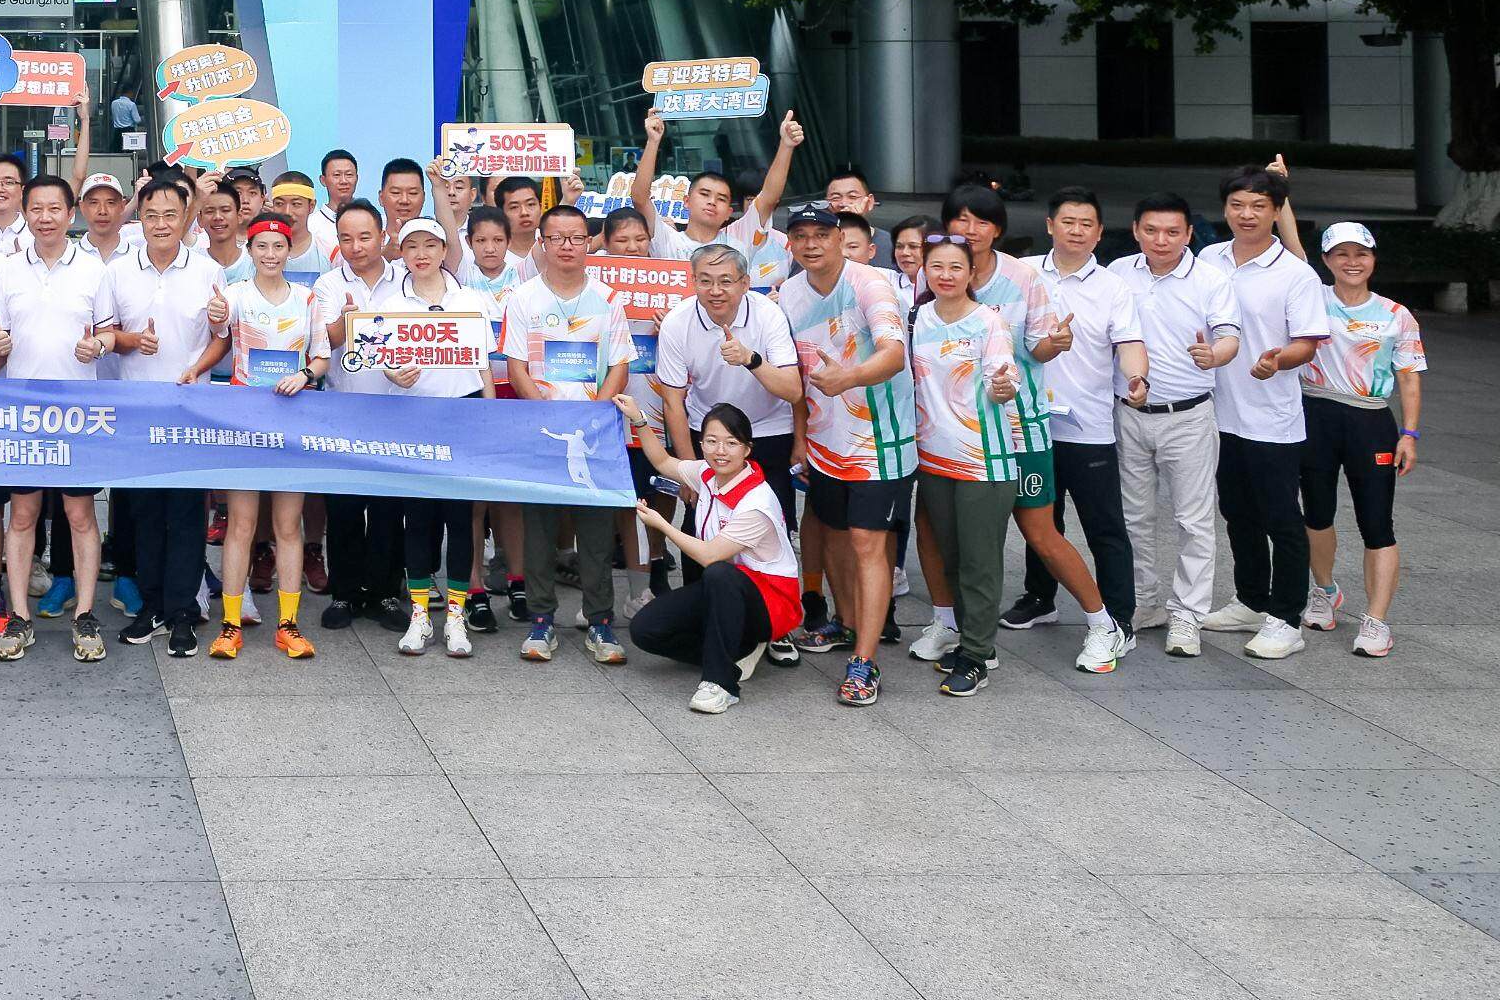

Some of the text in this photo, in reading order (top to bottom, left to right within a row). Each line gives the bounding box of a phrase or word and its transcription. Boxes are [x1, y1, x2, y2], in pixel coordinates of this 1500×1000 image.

[169, 50, 228, 79] 残特奥会
[650, 63, 754, 86] 喜迎残特奥
[662, 90, 766, 114] 欢聚大湾区
[180, 104, 254, 140] 残特奥会
[489, 133, 548, 152] 500天
[396, 322, 460, 344] 500天
[149, 426, 285, 450] 携手共进超越自我
